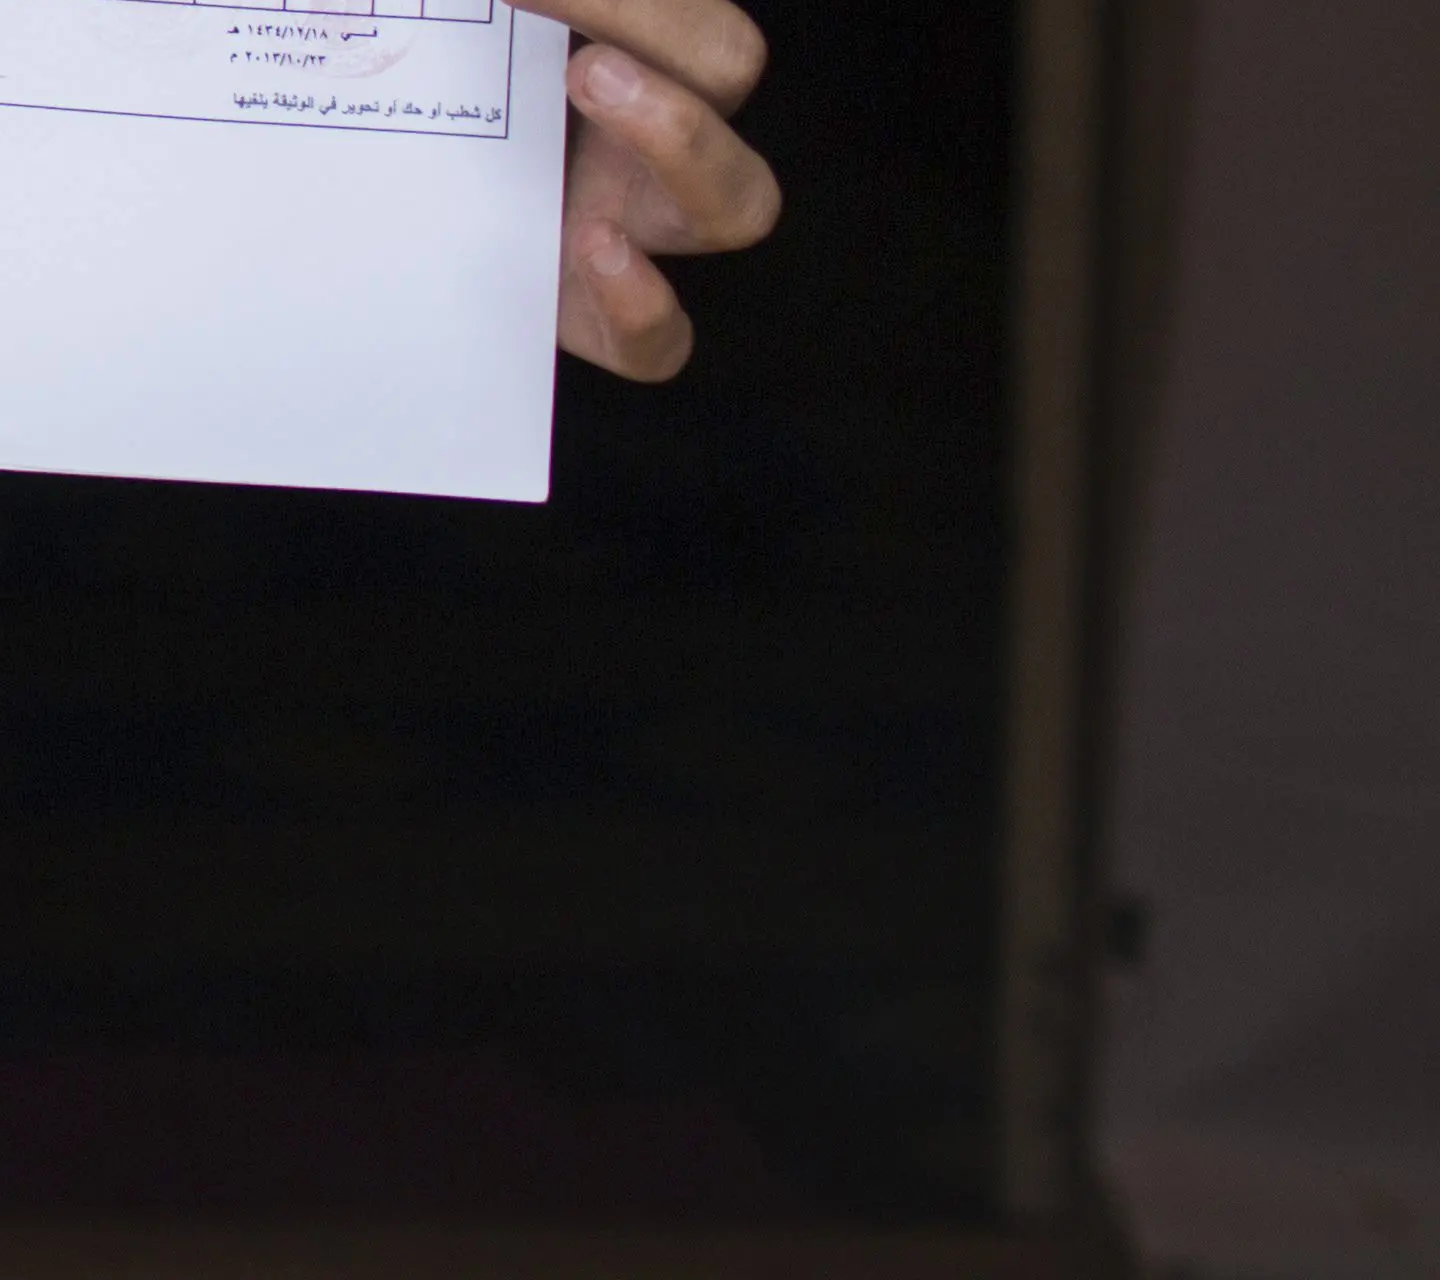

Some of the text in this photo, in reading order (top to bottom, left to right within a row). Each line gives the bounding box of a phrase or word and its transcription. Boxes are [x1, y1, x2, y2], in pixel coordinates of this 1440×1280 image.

[272, 94, 313, 110] الوثيقة
[319, 96, 336, 115] في
[446, 106, 480, 119] شطب
[485, 109, 502, 122] كل
